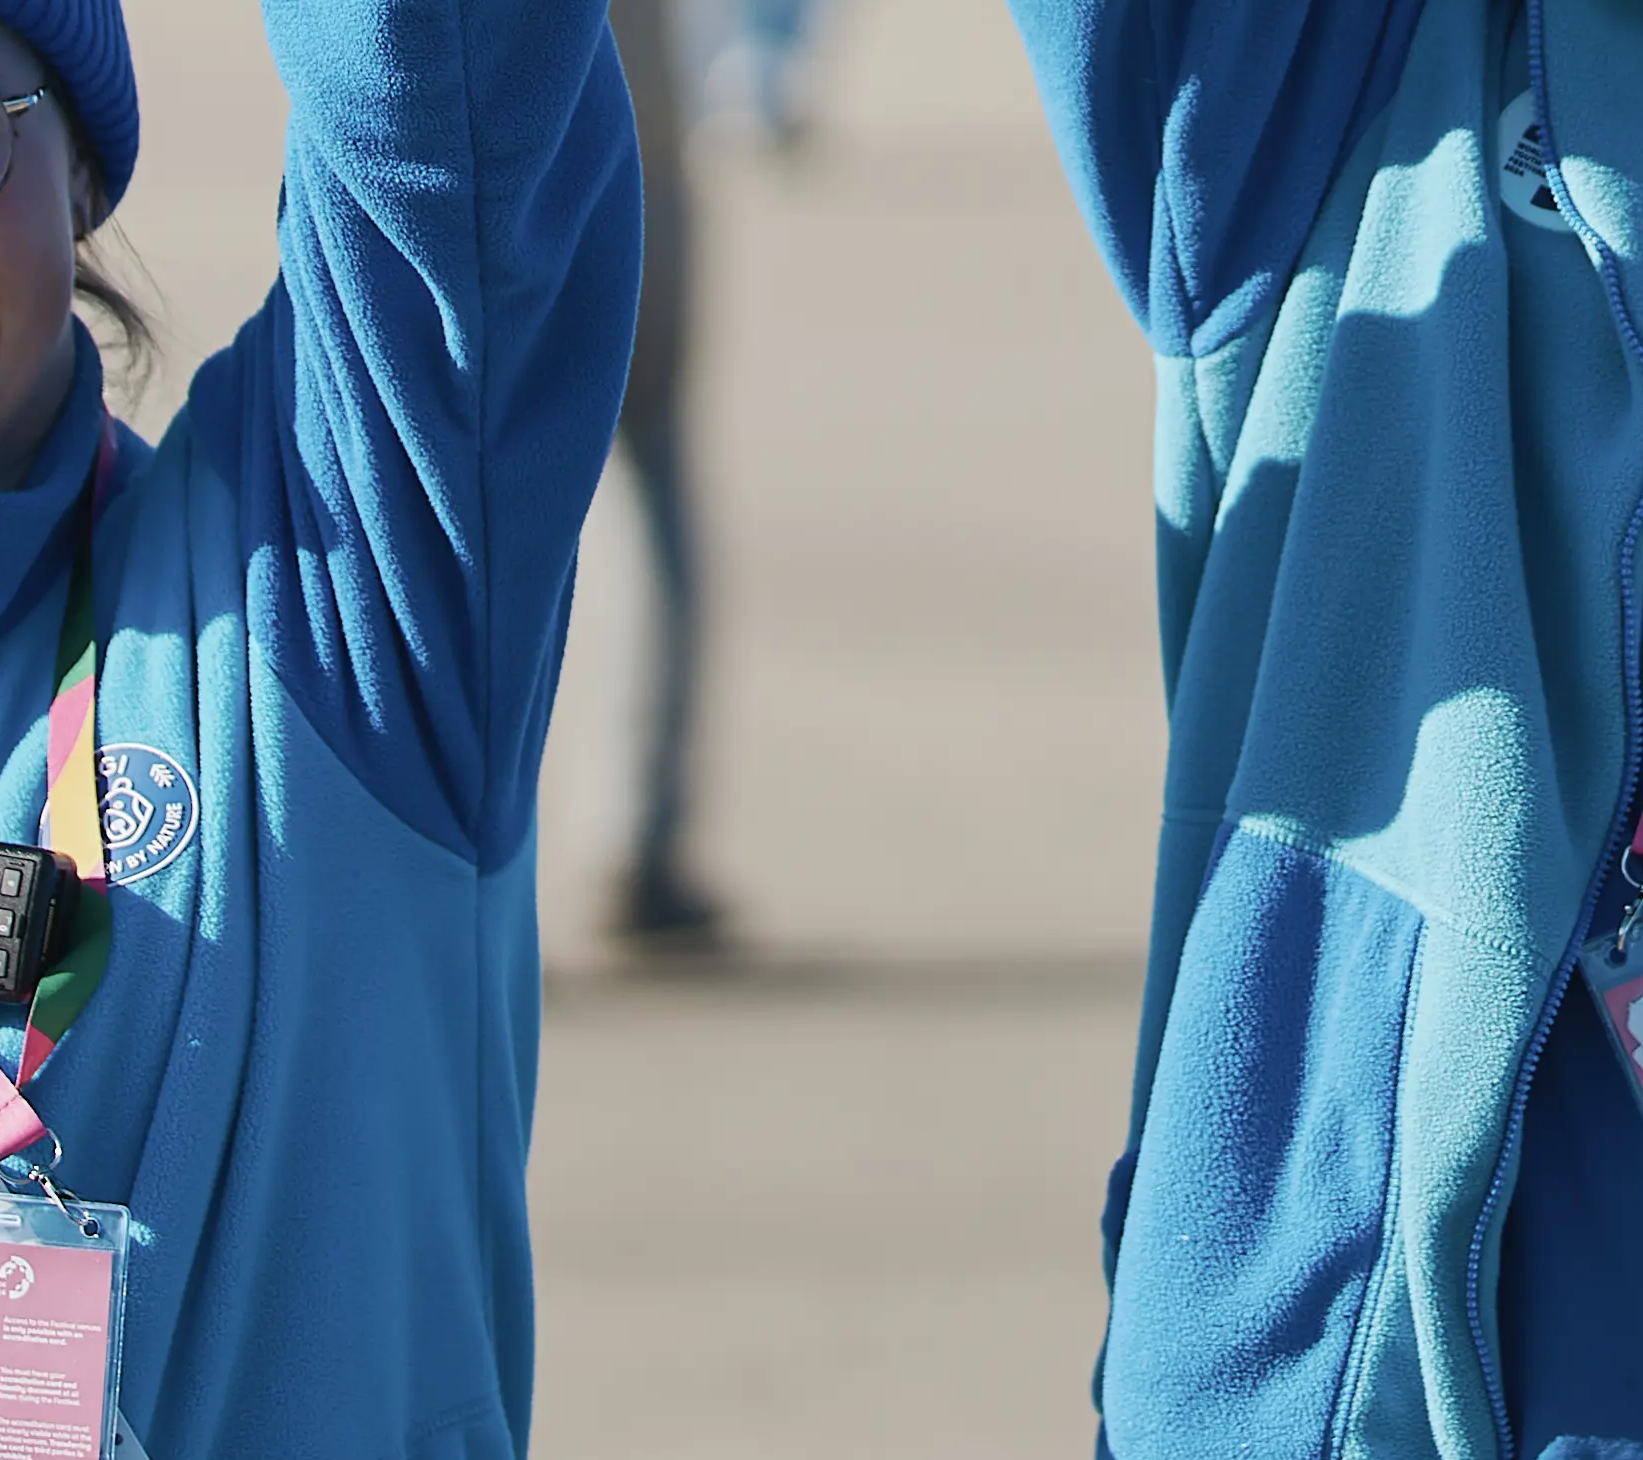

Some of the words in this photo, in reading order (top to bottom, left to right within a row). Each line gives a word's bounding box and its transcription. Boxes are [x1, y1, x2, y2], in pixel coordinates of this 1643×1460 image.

[99, 754, 128, 777] GI
[126, 849, 148, 869] BY
[146, 802, 184, 856] NATURE
